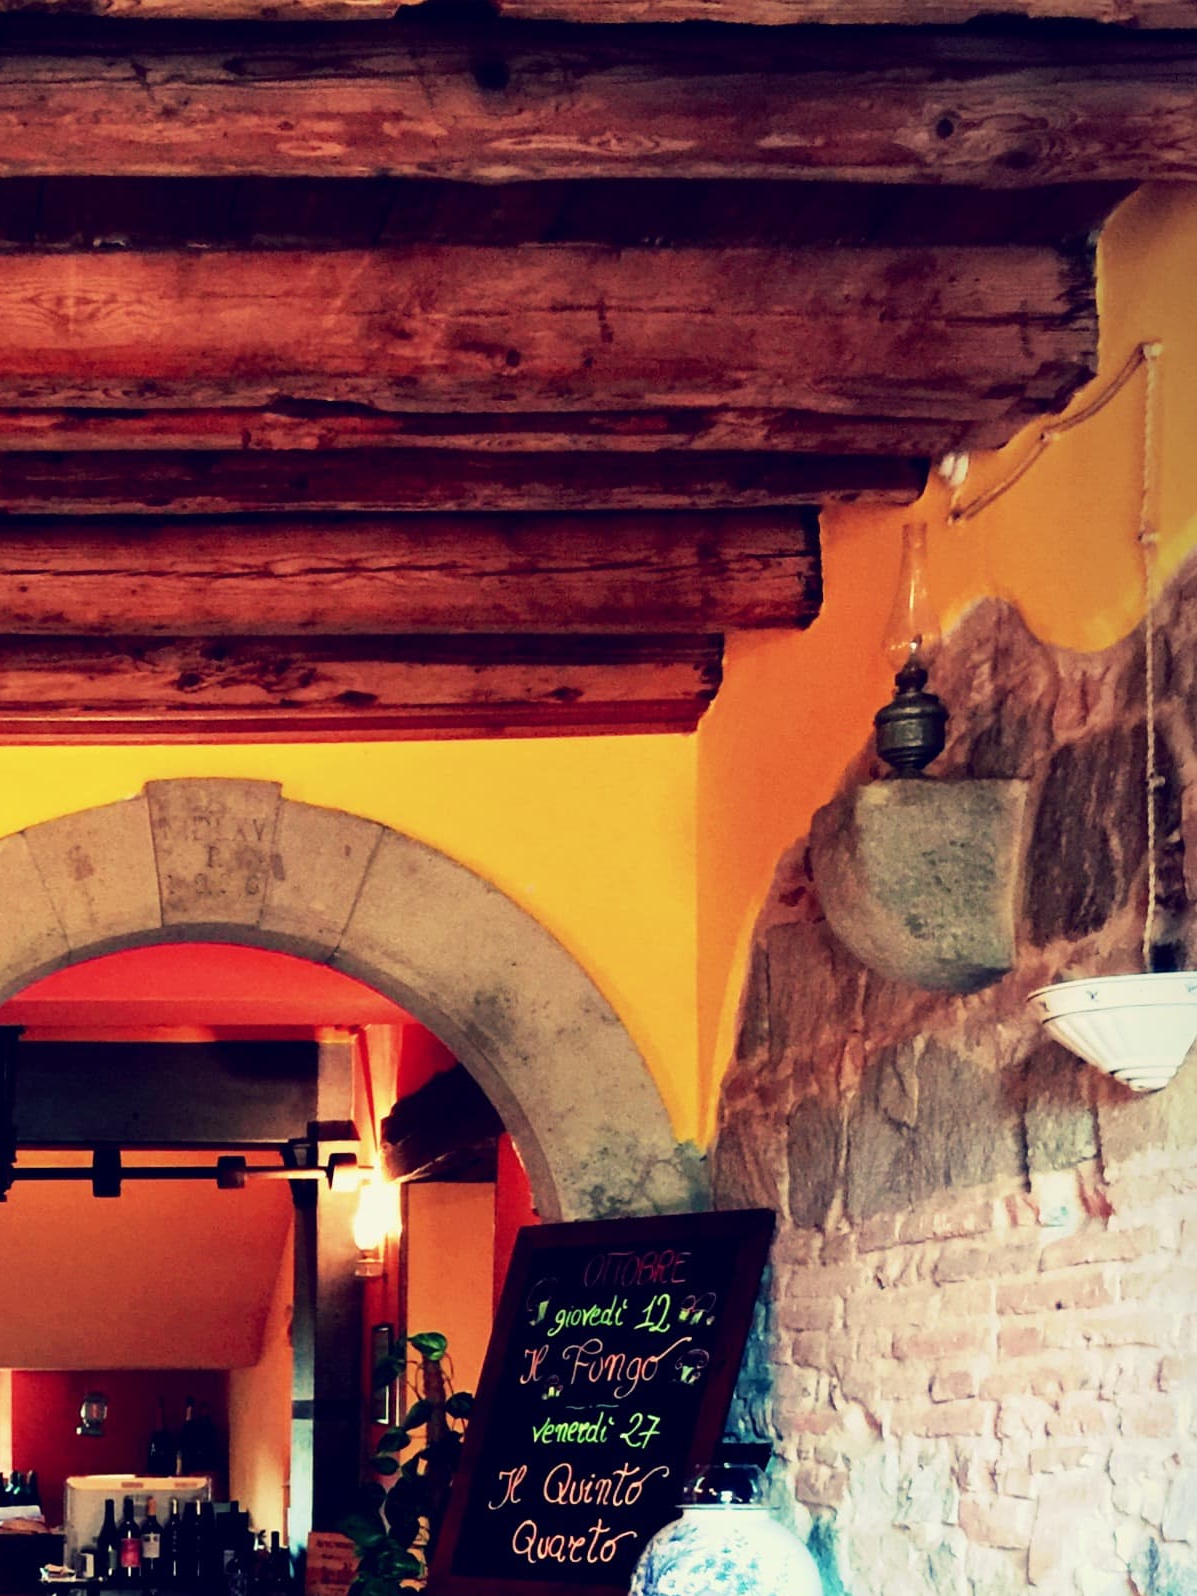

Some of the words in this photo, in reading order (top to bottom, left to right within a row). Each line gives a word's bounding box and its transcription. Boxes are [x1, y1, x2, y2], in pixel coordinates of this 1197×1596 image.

[583, 1249, 693, 1287] OTTOBRE
[633, 1293, 672, 1333] 12
[519, 1344, 550, 1386] Il
[562, 1337, 693, 1399] Fungo
[619, 1412, 661, 1449] 27
[488, 1464, 528, 1510] Il
[543, 1462, 670, 1507] Quinto
[512, 1518, 638, 1564] Quarto
